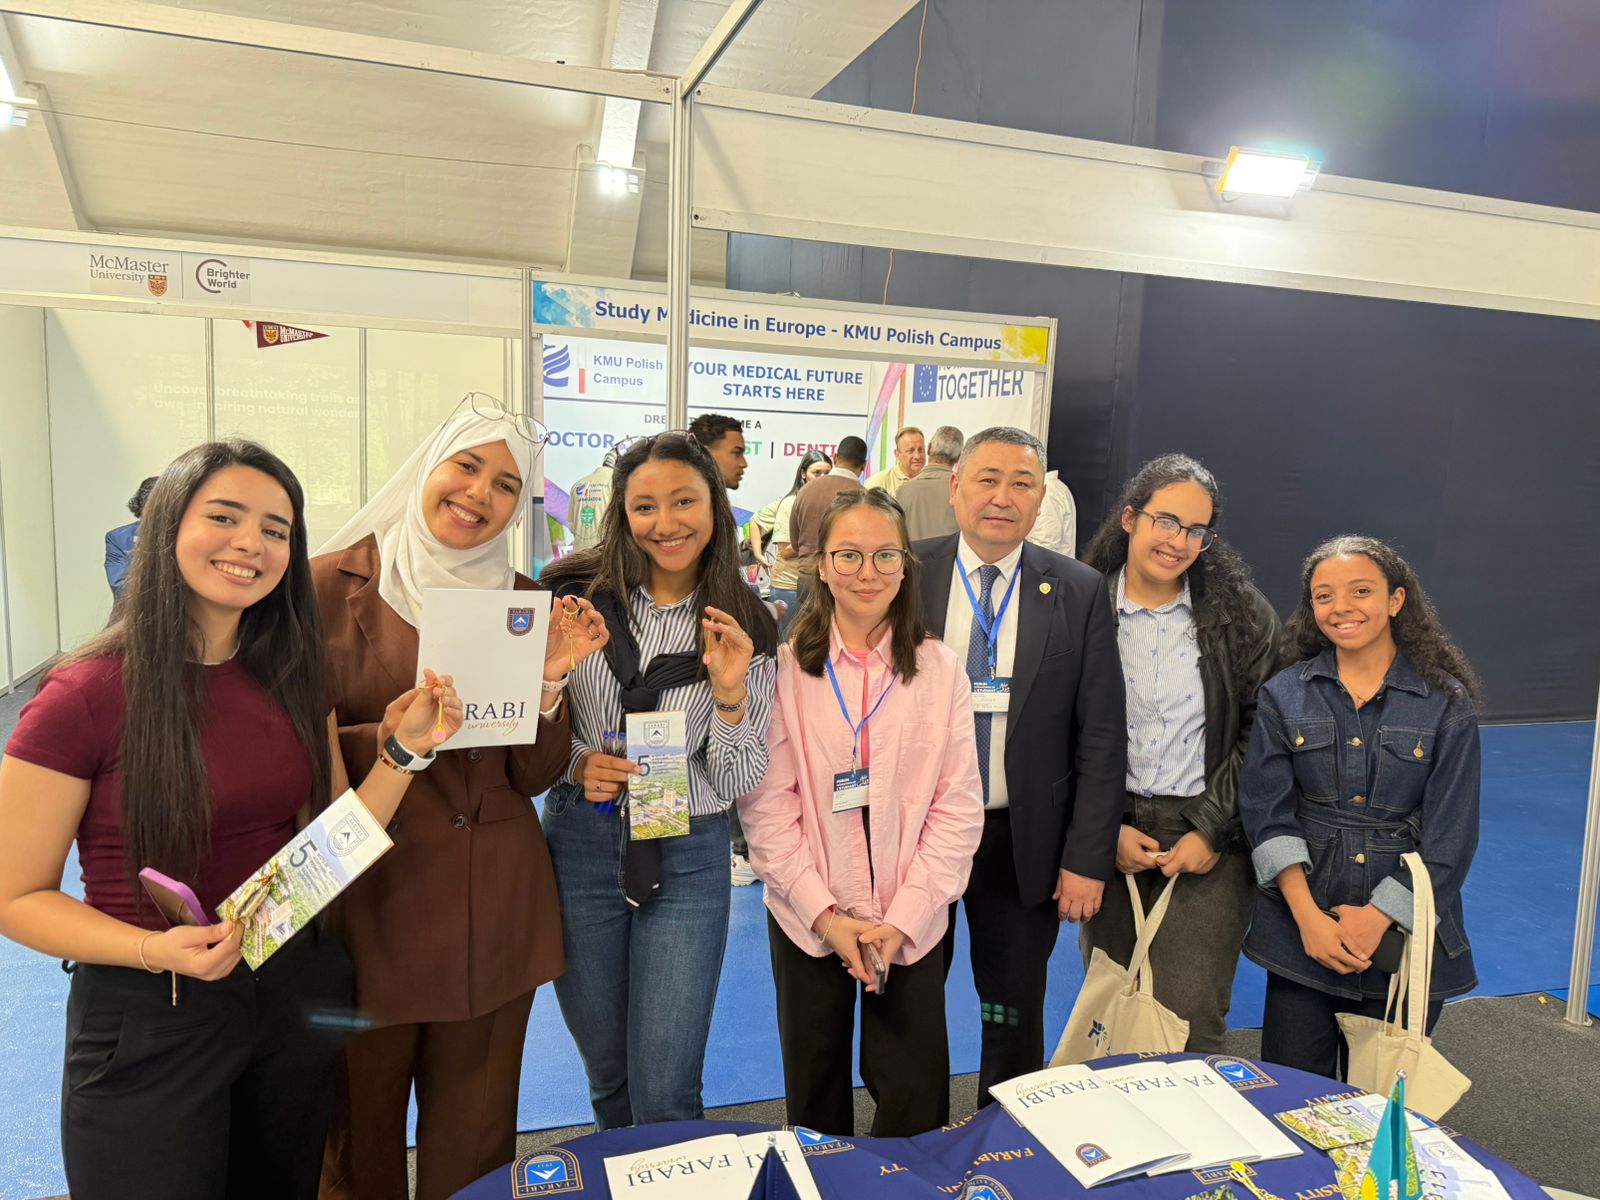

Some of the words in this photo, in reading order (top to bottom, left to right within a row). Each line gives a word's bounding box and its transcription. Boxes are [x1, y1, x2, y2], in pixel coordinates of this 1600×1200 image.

[89, 254, 169, 274] McMaster
[90, 268, 145, 284] University
[206, 267, 251, 281] Brighter
[207, 278, 237, 289] World
[595, 300, 651, 324] Study
[657, 306, 738, 328] Mdicine
[744, 314, 759, 330] in
[766, 317, 826, 338] Europe
[843, 324, 881, 340] KMU
[887, 327, 934, 345] Polish
[939, 332, 1001, 351] Campus
[593, 355, 623, 368] KMU
[626, 357, 663, 370] Polish
[593, 373, 643, 387] Campus
[733, 365, 802, 381] MEDICAL
[806, 369, 863, 385] FUTURE
[723, 383, 781, 399] STARTS
[786, 388, 825, 401] HERE
[938, 368, 1024, 401] TOGETHER
[644, 414, 667, 424] DRE
[547, 430, 615, 448] OCTOR
[783, 442, 837, 458] DENTI
[464, 701, 526, 720] RABI
[637, 755, 651, 777] 5
[289, 839, 318, 868] 5
[1015, 1077, 1100, 1109] FARABI
[1113, 1076, 1176, 1094] FARA
[626, 1152, 733, 1187] FARABI
[525, 1181, 571, 1193] FARABI
